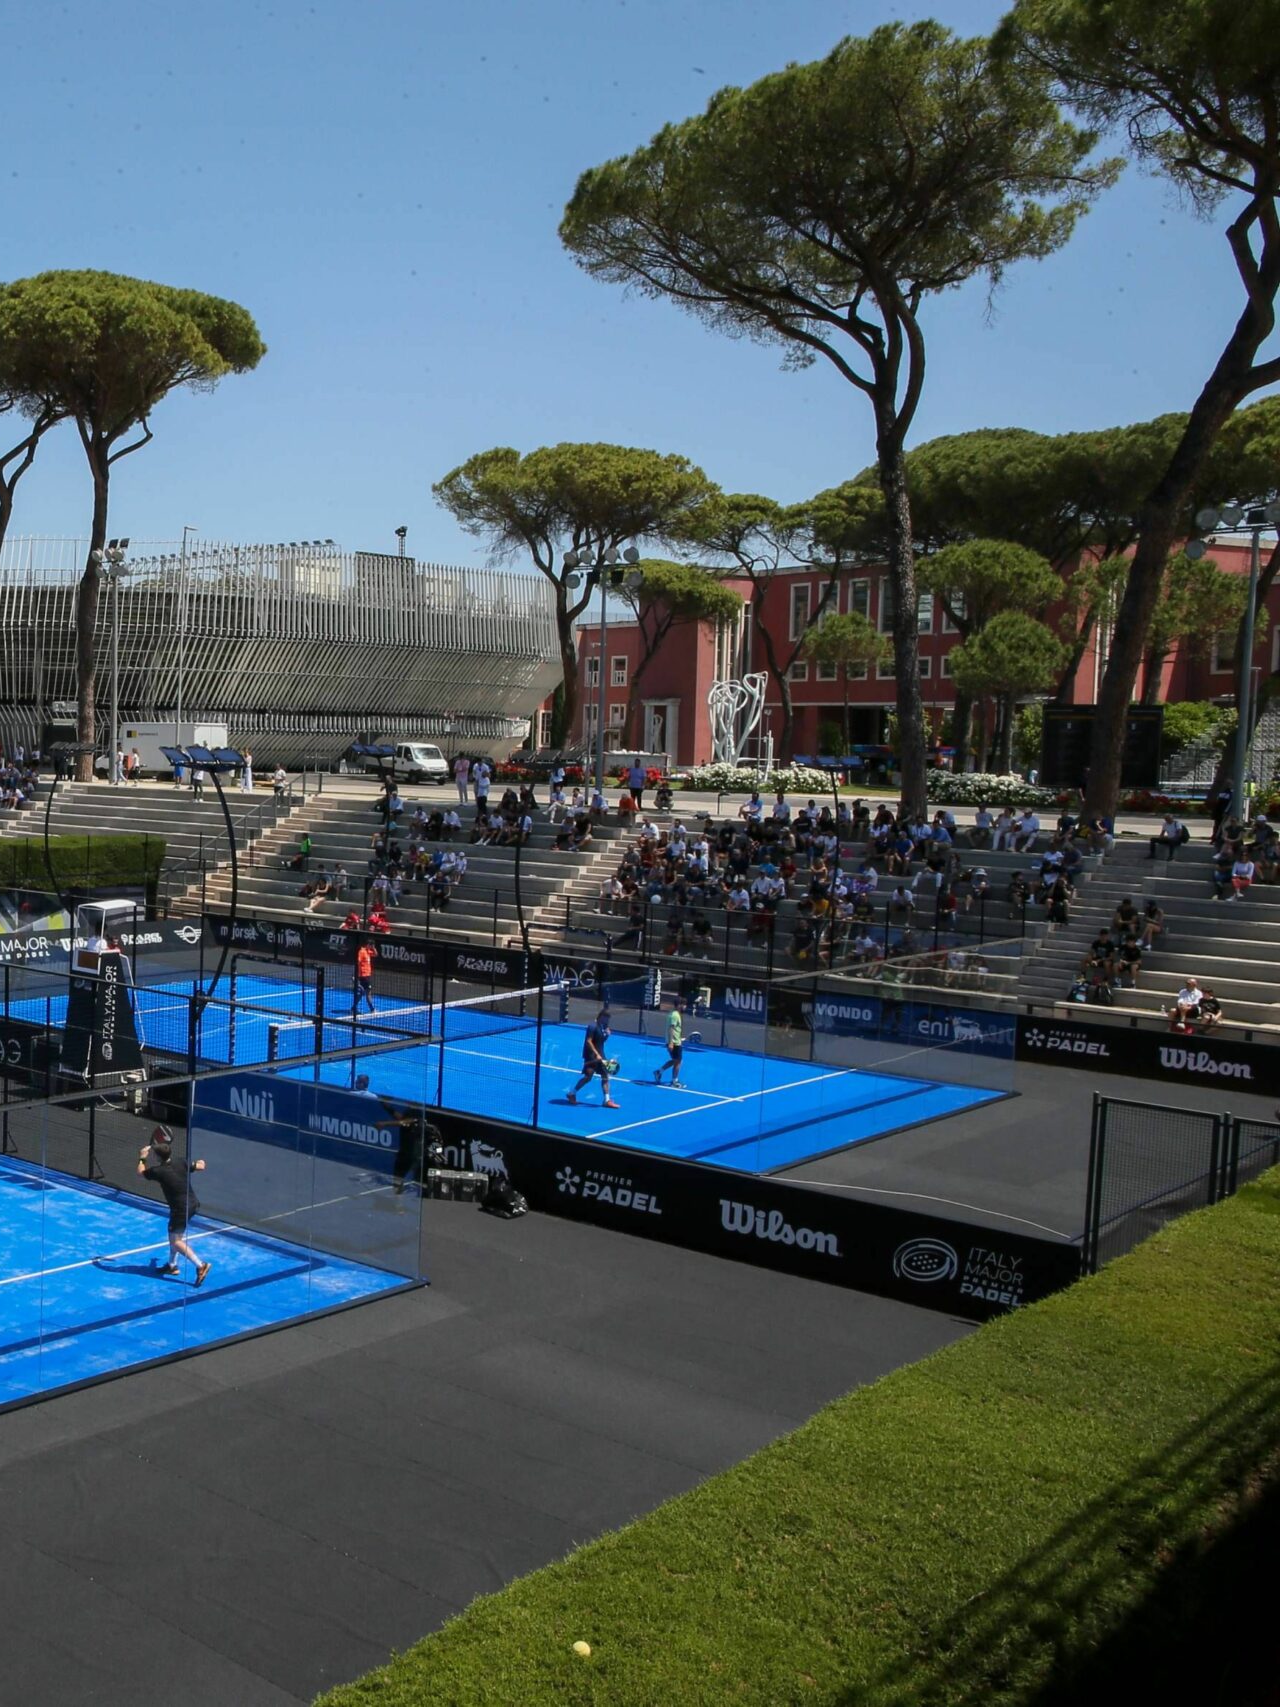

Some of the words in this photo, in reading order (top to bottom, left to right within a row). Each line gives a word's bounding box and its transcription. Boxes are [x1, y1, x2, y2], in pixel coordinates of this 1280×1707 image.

[1, 937, 47, 952] MAJOR
[380, 944, 425, 964] Wilson
[543, 964, 594, 988] SWAG
[725, 988, 763, 1011] Nuii
[816, 1003, 872, 1021] MONDO
[918, 1017, 949, 1037] eni
[1050, 1030, 1087, 1039] PREMIER
[1046, 1038, 1110, 1056] PADEL
[1159, 1046, 1251, 1079] Wilson
[230, 1087, 275, 1123] Nuii
[322, 1116, 392, 1148] MONDO
[586, 1170, 633, 1186] PREMIER
[582, 1182, 662, 1215] PADEL
[720, 1198, 842, 1258] Wilson
[968, 1247, 1023, 1269] ITALY
[964, 1261, 1023, 1283] MAJOR
[959, 1282, 1022, 1307] PADEL
[963, 1275, 1024, 1294] PREMIER
